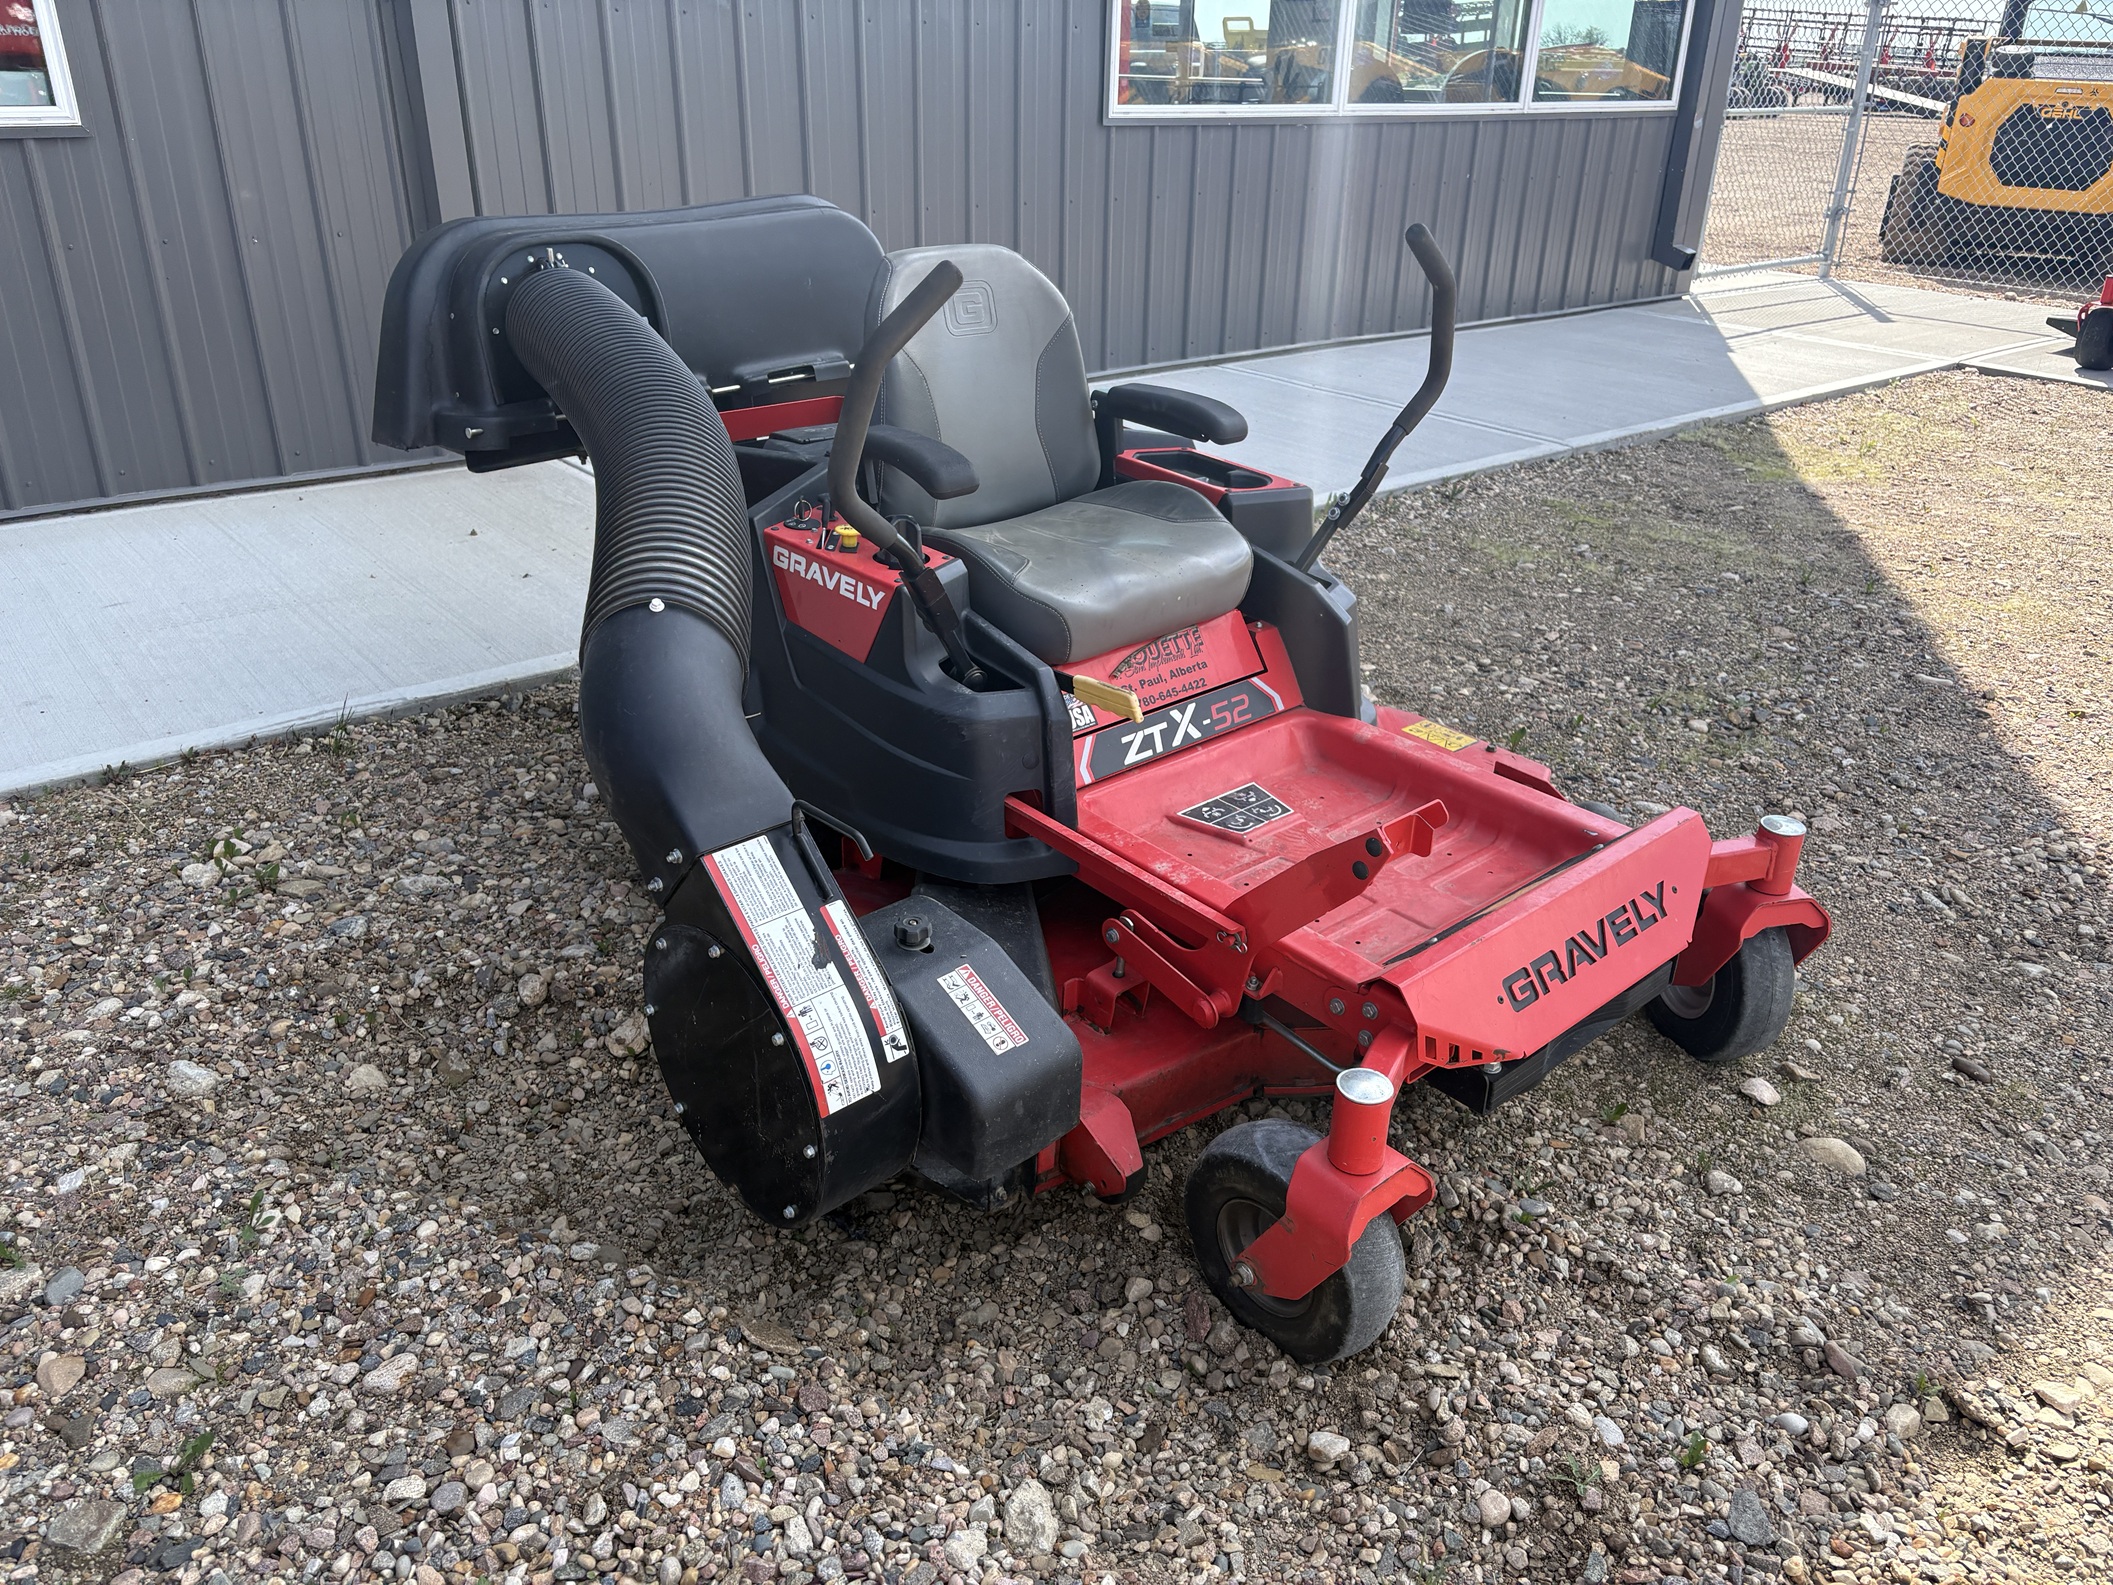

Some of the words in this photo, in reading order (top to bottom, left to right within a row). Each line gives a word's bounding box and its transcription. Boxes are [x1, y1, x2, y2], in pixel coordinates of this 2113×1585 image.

[773, 545, 886, 611] GRAVELY
[1139, 673, 1168, 690] Paul,
[1169, 661, 1209, 680] Alberta
[752, 944, 771, 975] PELIGRO
[834, 934, 854, 966] PELIGRO
[1501, 880, 1668, 1013] GRAVELY
[769, 979, 789, 1009] DANGER
[852, 970, 872, 1001] DANGER
